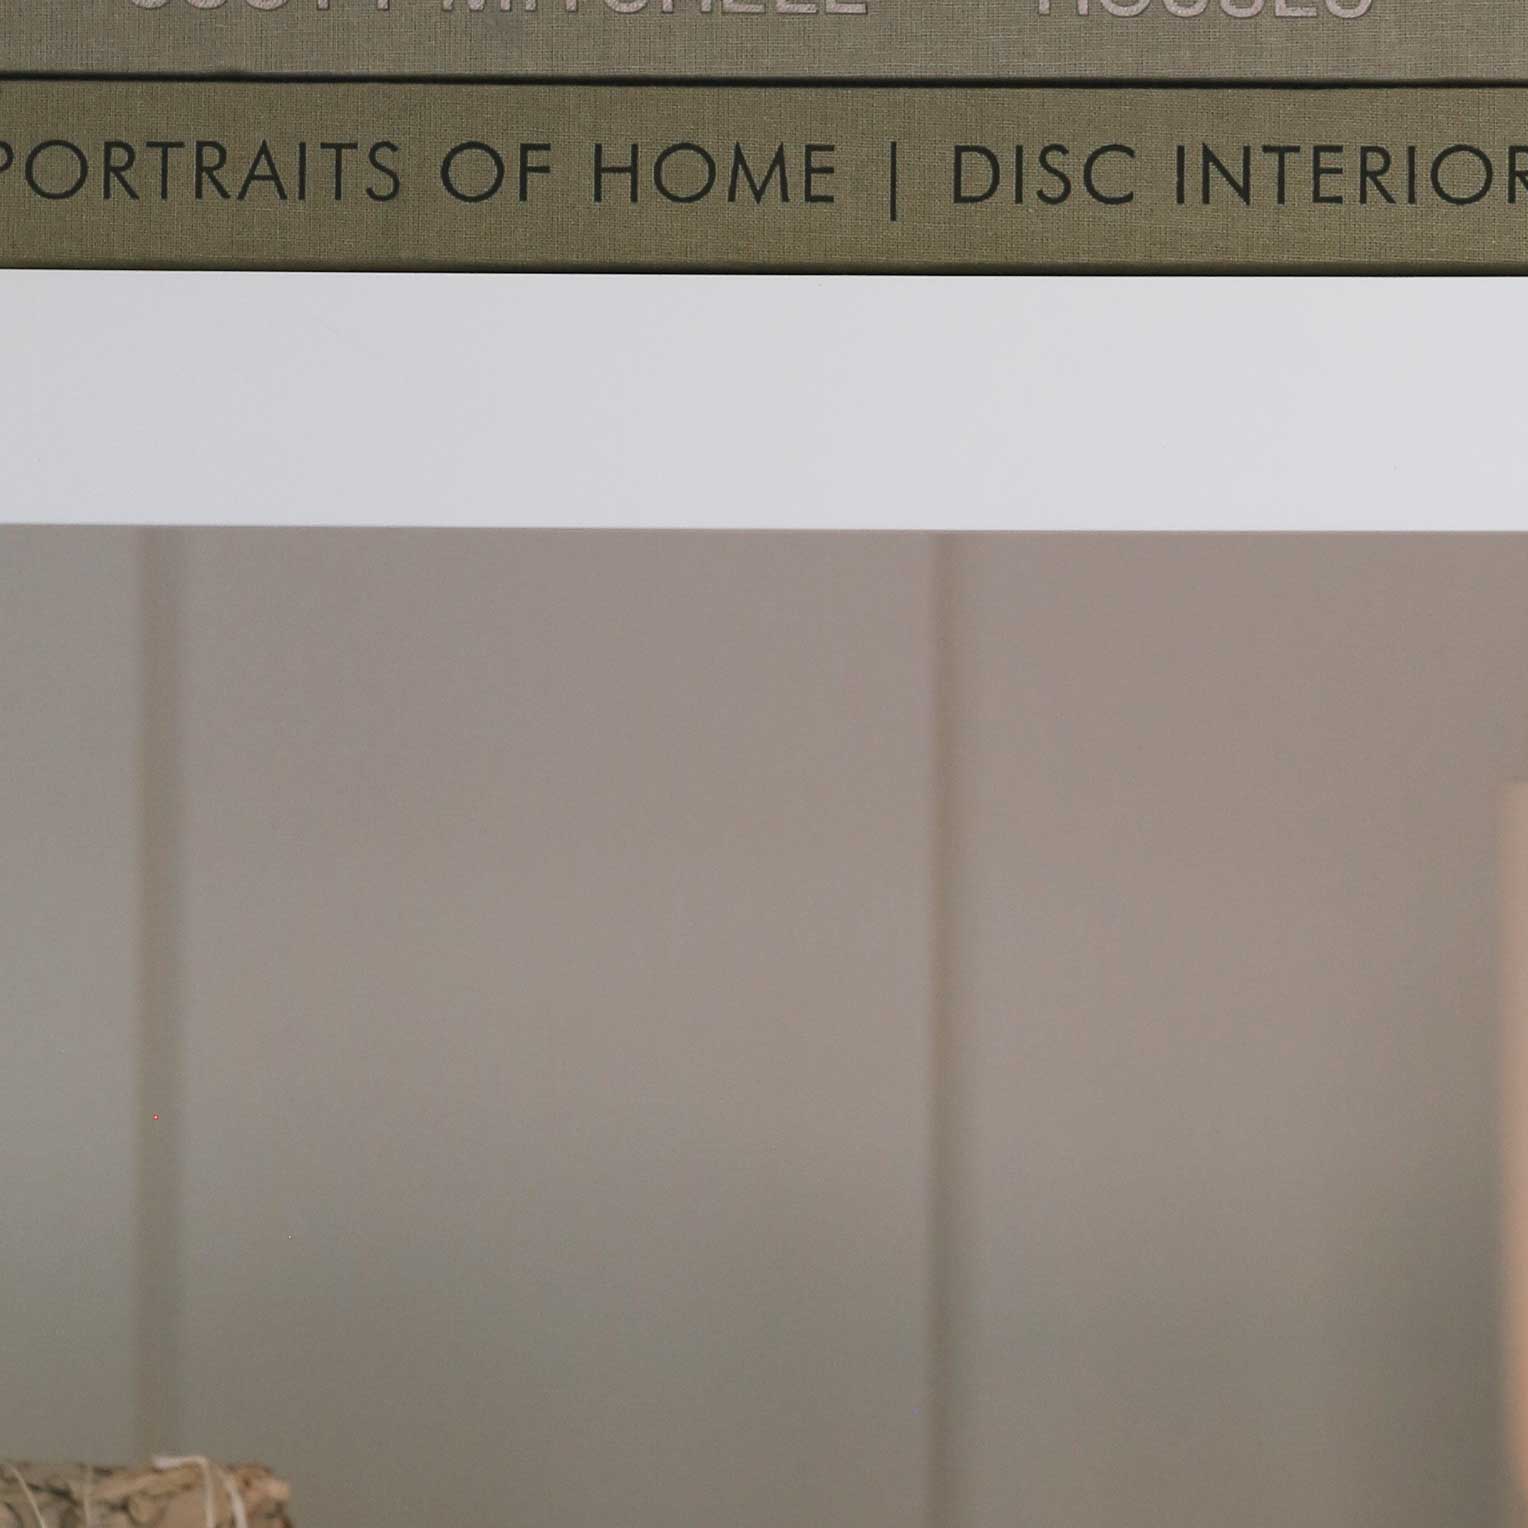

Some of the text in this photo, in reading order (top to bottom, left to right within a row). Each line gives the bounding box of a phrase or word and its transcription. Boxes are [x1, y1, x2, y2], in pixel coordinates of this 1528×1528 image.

[440, 140, 551, 203] OF
[594, 143, 836, 204] HOME
[950, 142, 1135, 205] DISC
